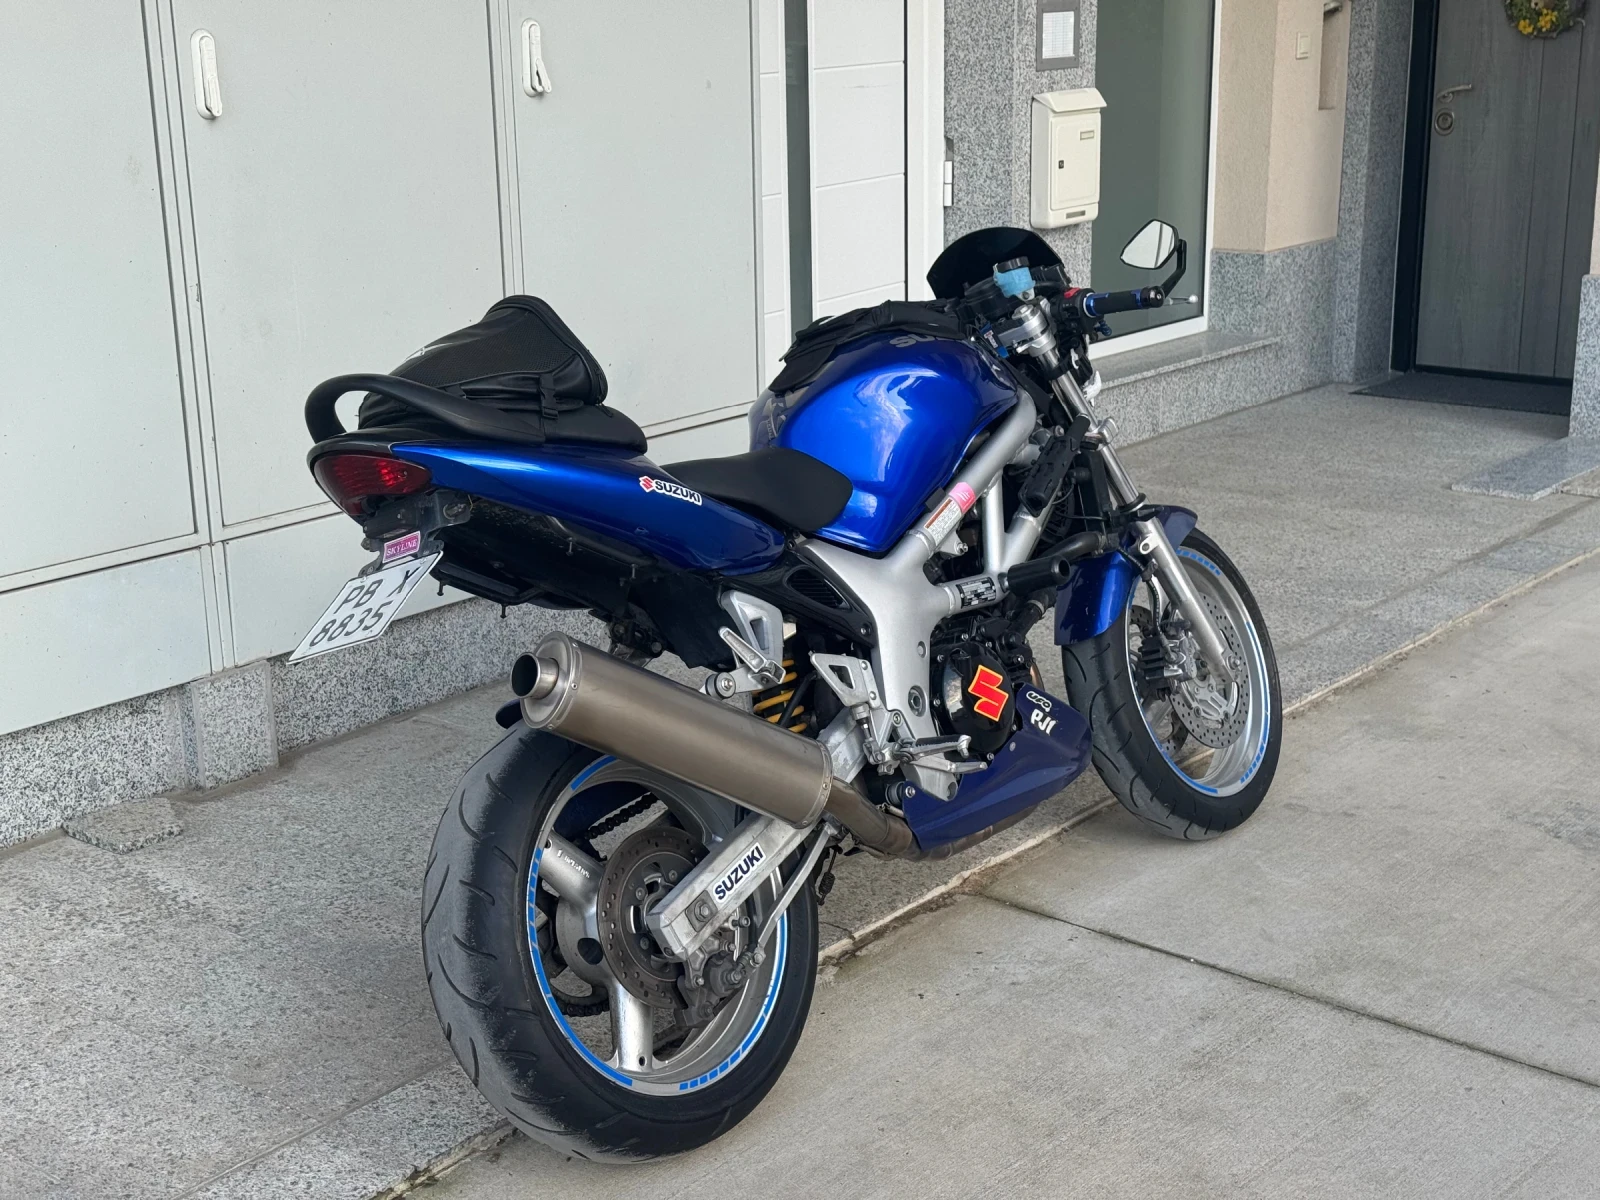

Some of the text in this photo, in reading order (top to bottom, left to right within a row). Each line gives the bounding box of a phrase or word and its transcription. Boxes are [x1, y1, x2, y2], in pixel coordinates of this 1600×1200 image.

[654, 480, 701, 503] SUZUKI
[386, 539, 418, 556] SKYLINE
[333, 579, 384, 615] PB
[309, 600, 394, 647] 8835
[714, 845, 764, 900] SUZUKI
